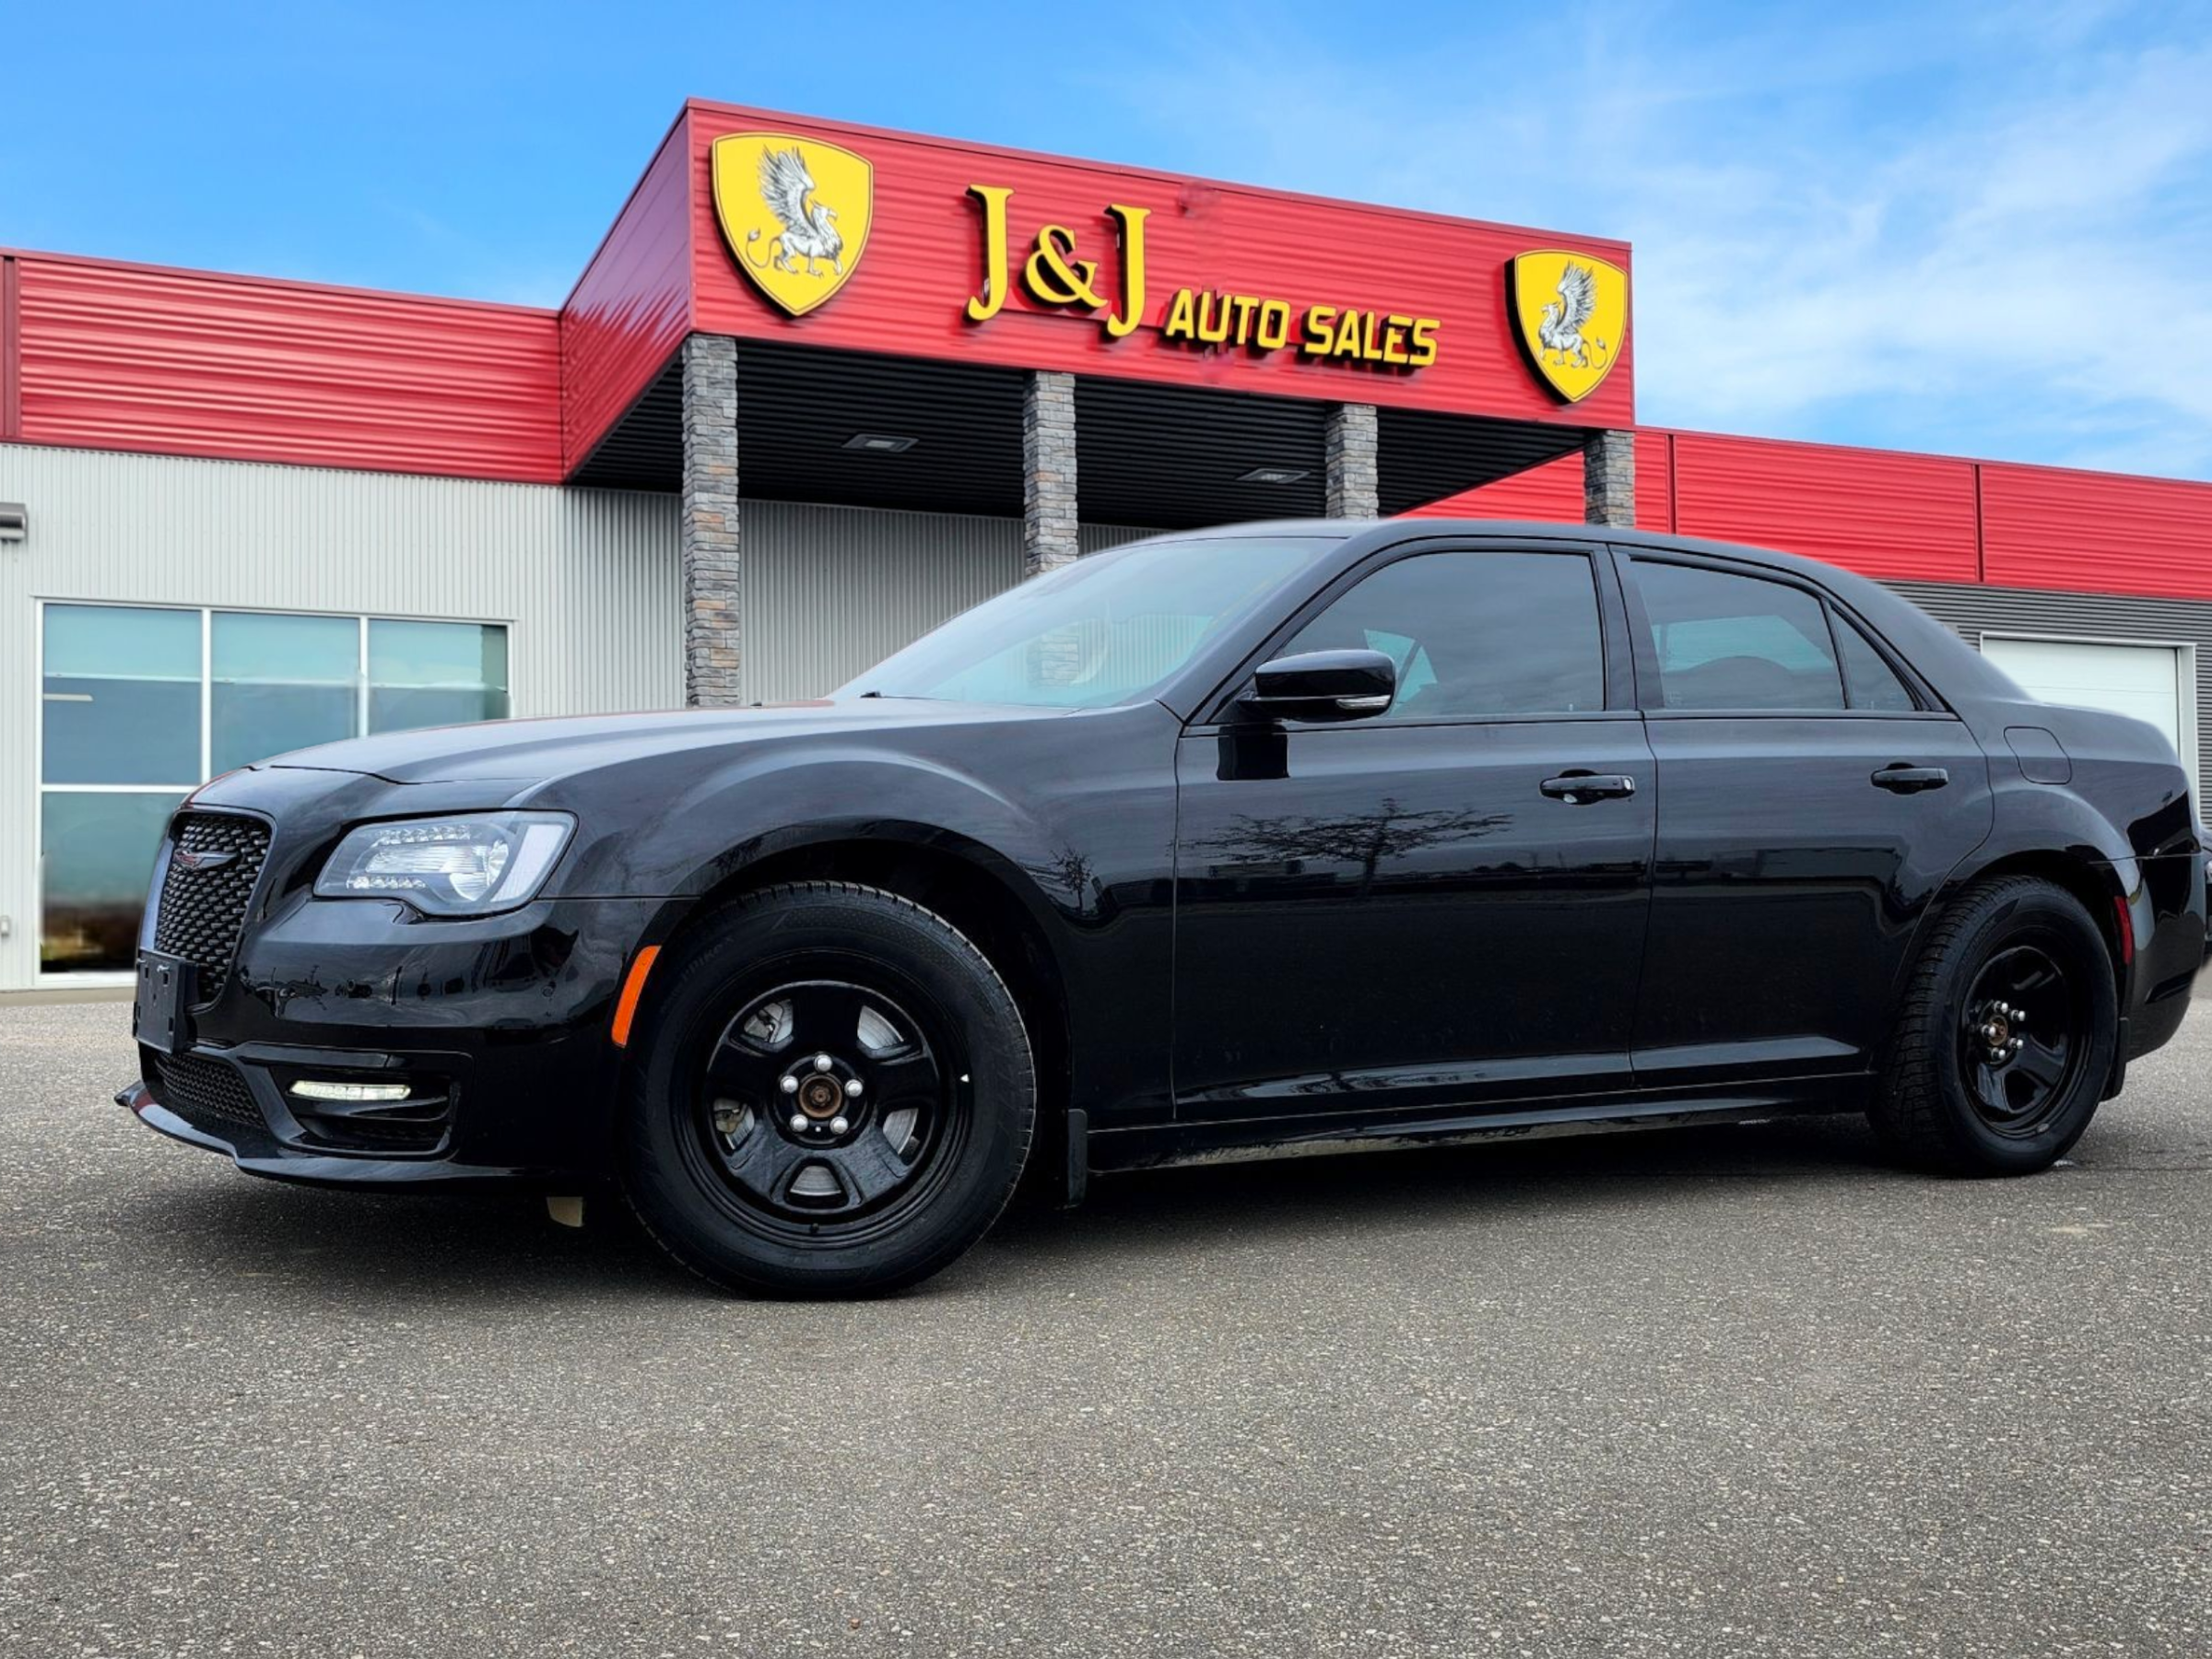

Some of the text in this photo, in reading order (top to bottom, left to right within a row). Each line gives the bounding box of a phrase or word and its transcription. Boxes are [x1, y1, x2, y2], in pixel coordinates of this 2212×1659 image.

[966, 184, 1441, 367] J&J AUTO SALES
